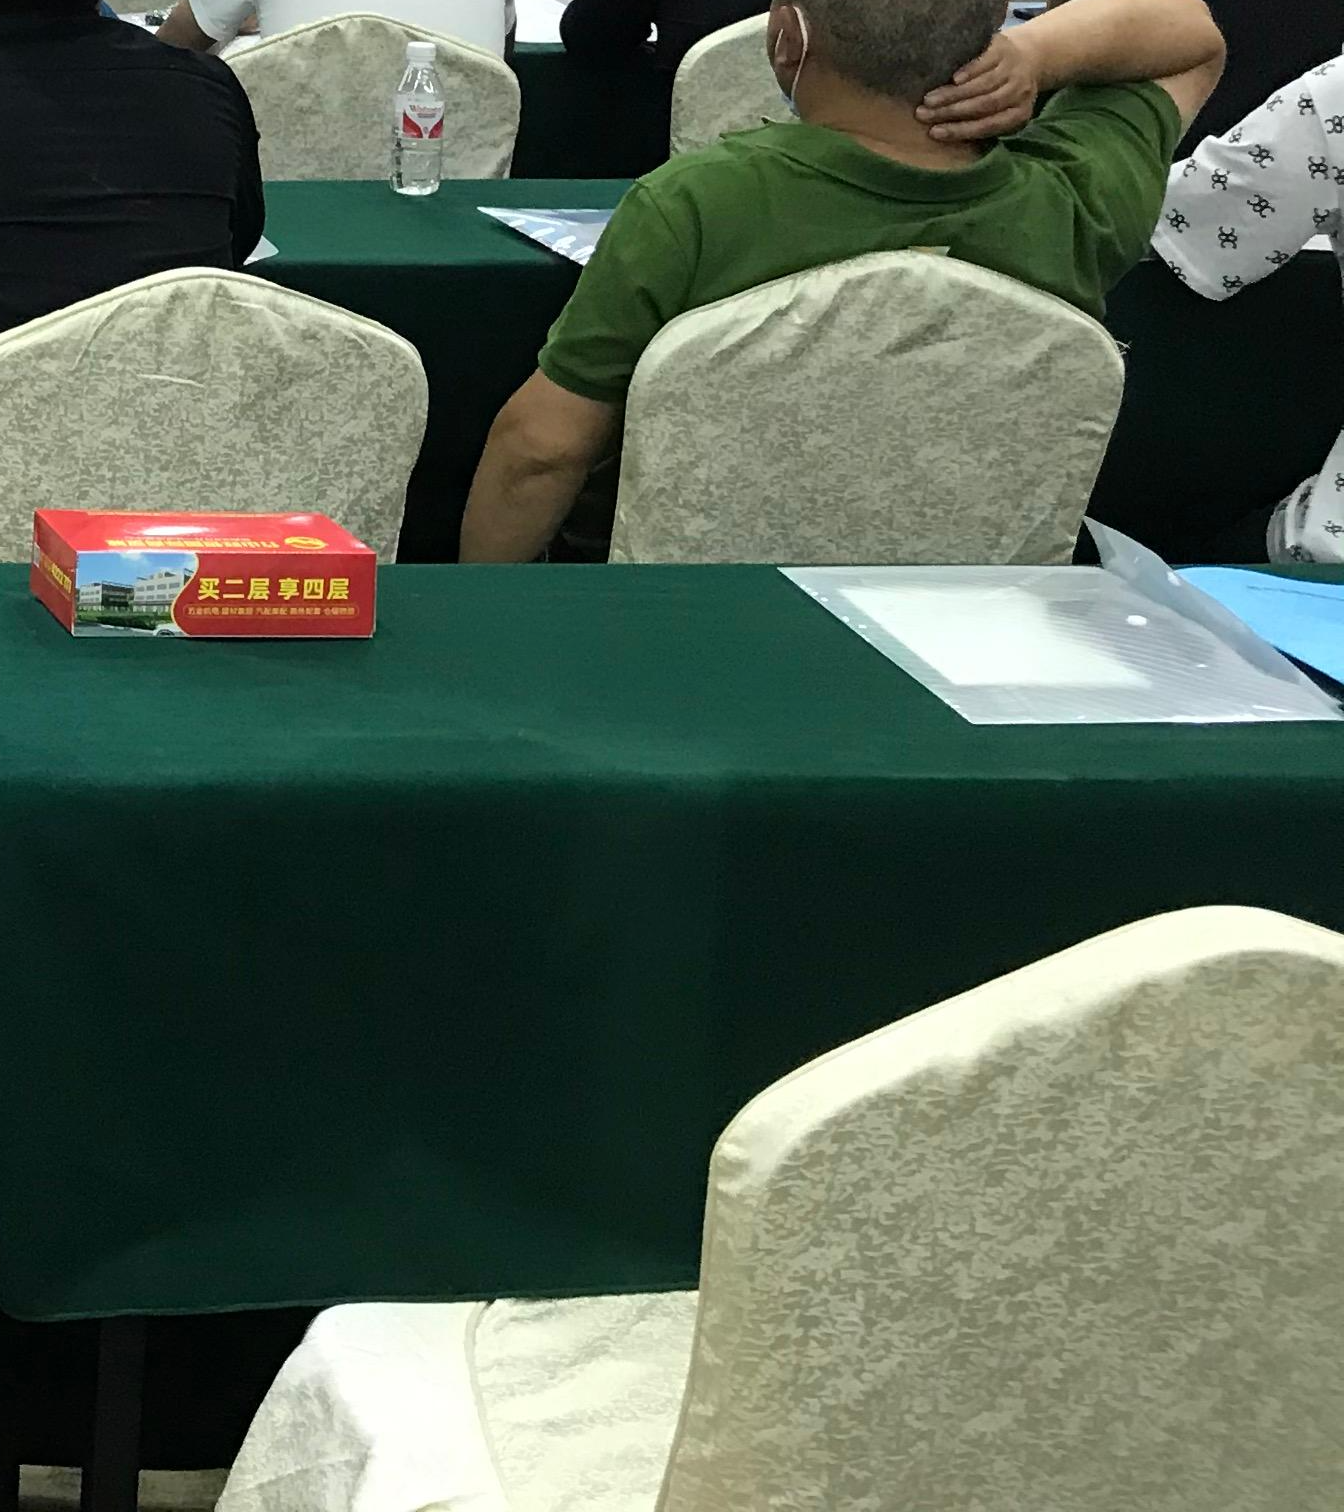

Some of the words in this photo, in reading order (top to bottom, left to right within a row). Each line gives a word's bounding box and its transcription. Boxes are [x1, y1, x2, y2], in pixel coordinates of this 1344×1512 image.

[198, 577, 270, 601] 买二层
[278, 577, 349, 601] 享四层
